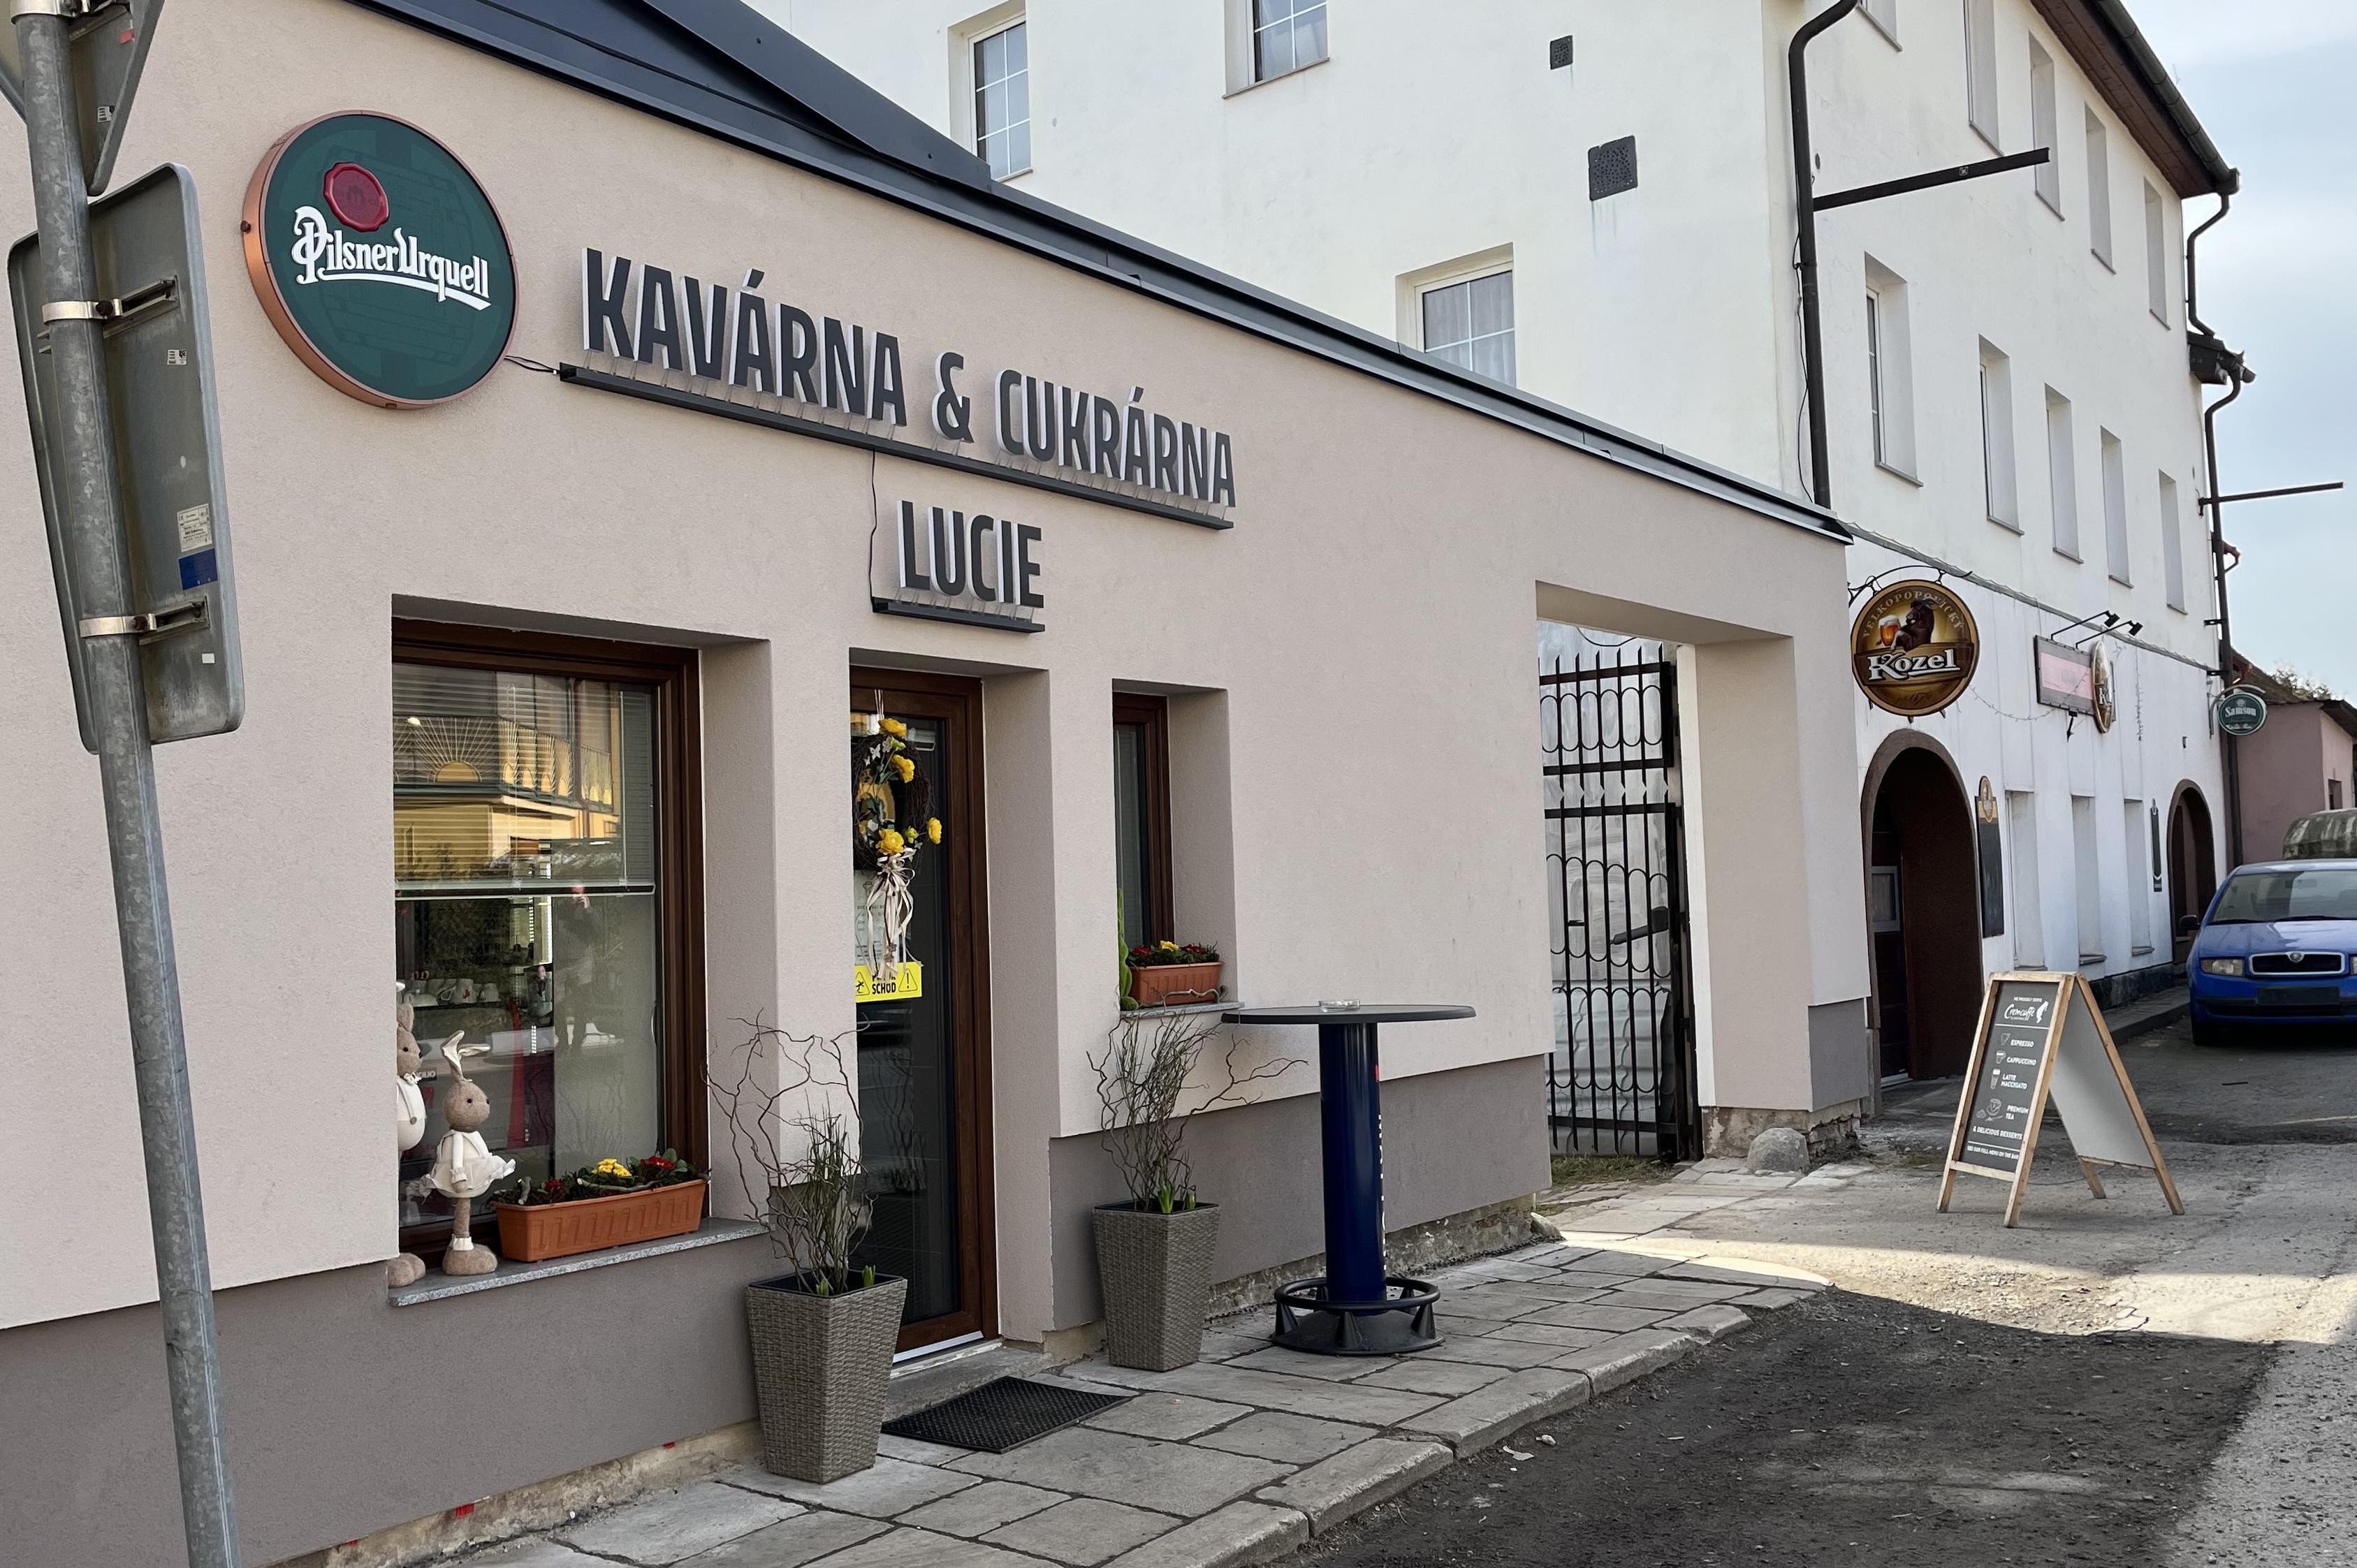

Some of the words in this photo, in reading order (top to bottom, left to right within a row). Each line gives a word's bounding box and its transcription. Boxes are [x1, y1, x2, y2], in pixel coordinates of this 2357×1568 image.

[291, 205, 399, 285] Pilsner
[393, 227, 490, 302] Urquell
[582, 247, 907, 427] KAVÁRNA
[932, 352, 975, 443] &
[995, 369, 1236, 507] CUKRÁRNA
[897, 500, 1044, 608] LUCIE
[1867, 648, 1957, 682] Kozel
[872, 982, 896, 995] SCHOD
[2011, 1039, 2034, 1048] ESPRESSO
[2006, 1057, 2037, 1066] CAPPUCCINO
[2001, 1080, 2027, 1090] MACCHIATO
[2007, 1105, 2029, 1113] PREMIUM
[1977, 1126, 1999, 1136] DELICIOUS
[2000, 1131, 2023, 1140] DESSERTS
